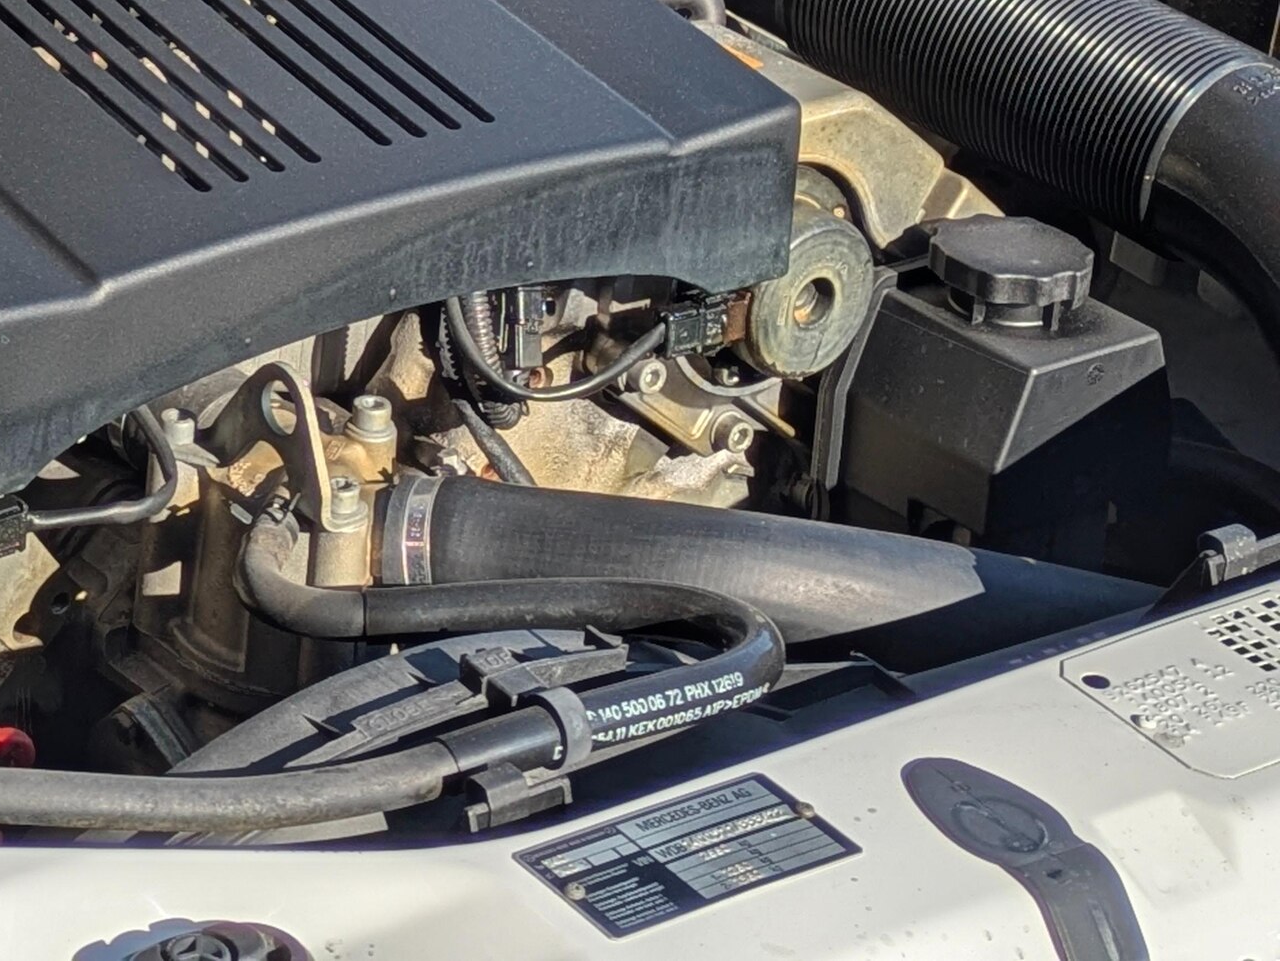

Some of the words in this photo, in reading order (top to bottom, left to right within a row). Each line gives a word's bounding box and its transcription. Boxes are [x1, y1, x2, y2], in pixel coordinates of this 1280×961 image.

[622, 698, 648, 718] 500
[648, 693, 666, 713] 06
[665, 689, 685, 707] 72
[685, 680, 713, 701] PHX
[635, 792, 733, 833] MERCEDES-BENZ
[735, 786, 753, 800] AG
